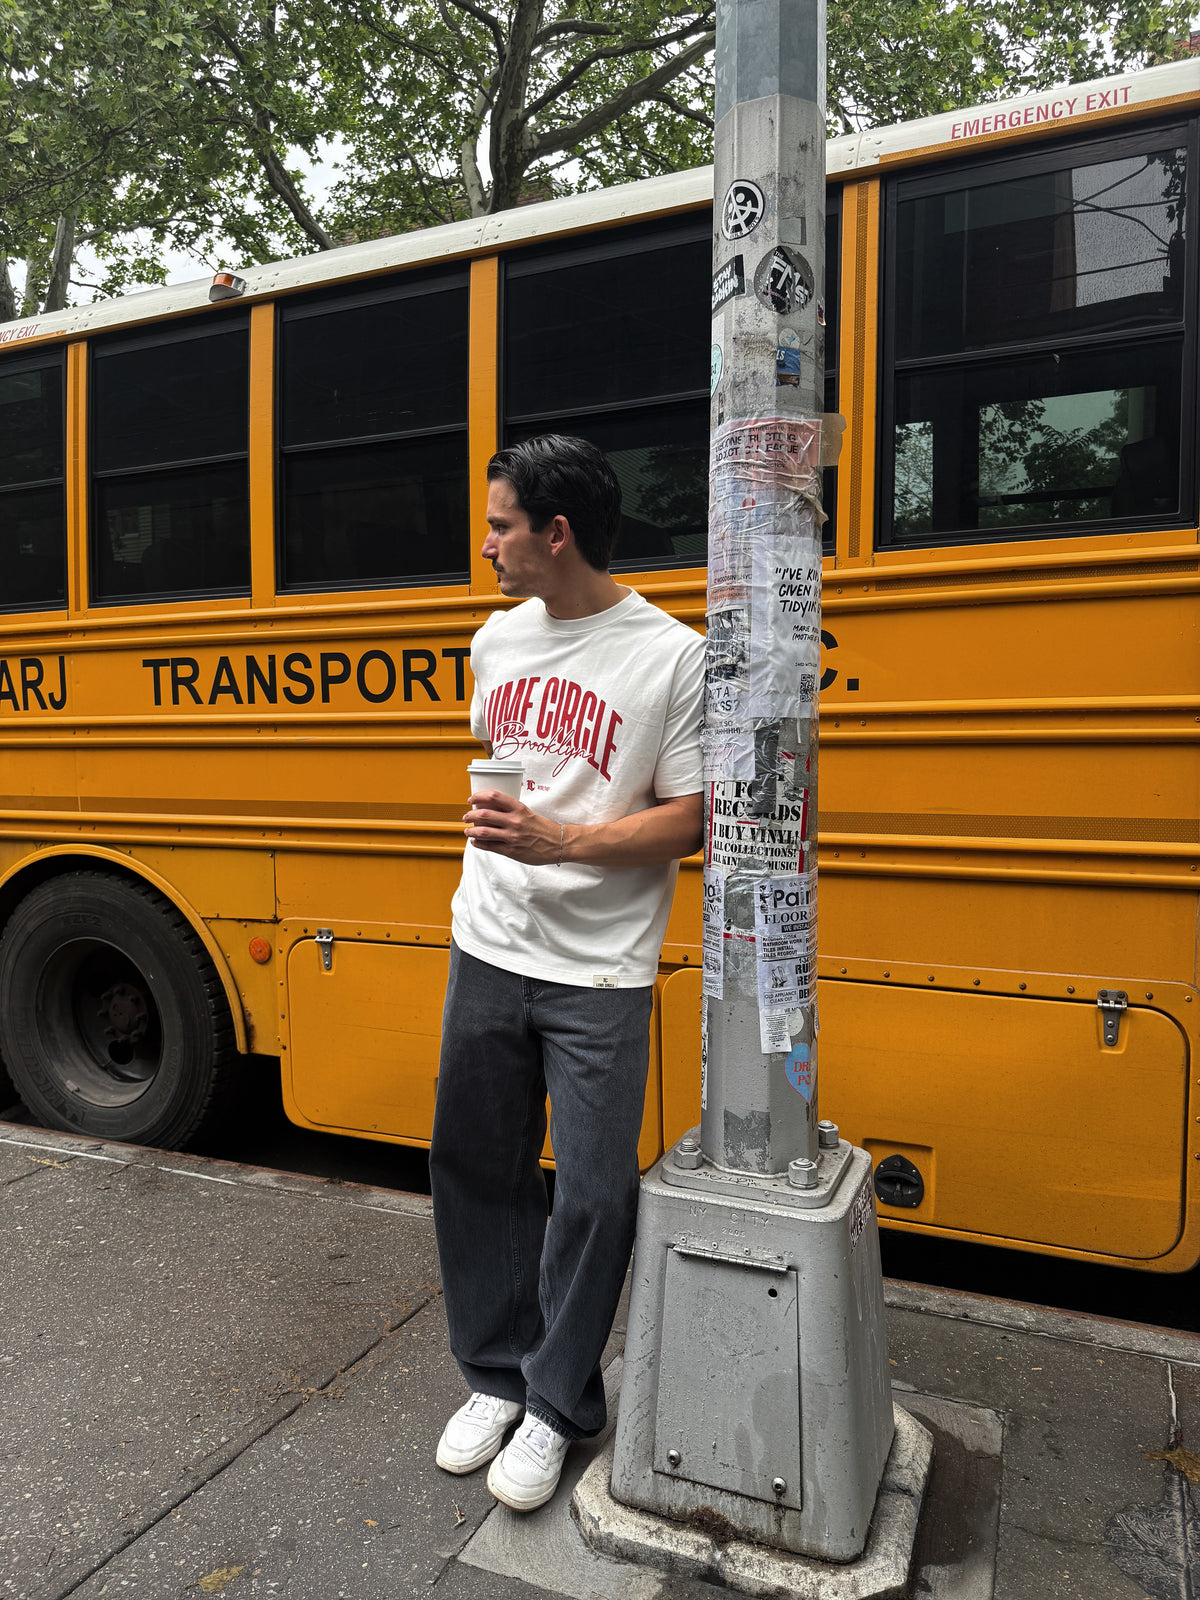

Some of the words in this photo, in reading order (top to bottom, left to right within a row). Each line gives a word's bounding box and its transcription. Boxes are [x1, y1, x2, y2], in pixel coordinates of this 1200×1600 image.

[951, 97, 1078, 140] EMERGENCY
[1086, 86, 1132, 112] EXIT
[17, 324, 41, 339] EXIT
[778, 584, 812, 597] GIVEN
[536, 677, 623, 783] CIRCLE
[494, 721, 593, 778] Brooklyn
[719, 823, 745, 841] BUY
[750, 827, 799, 845] VINYL!
[712, 840, 723, 851] ALL
[724, 842, 797, 858] COLLECTIONS!
[712, 852, 721, 864] ALL
[767, 860, 798, 871] MUSIC!
[764, 911, 808, 924] FLOOR
[775, 990, 797, 998] APPLIANCE
[688, 1205, 708, 1218] NY
[729, 1212, 770, 1228] CITY
